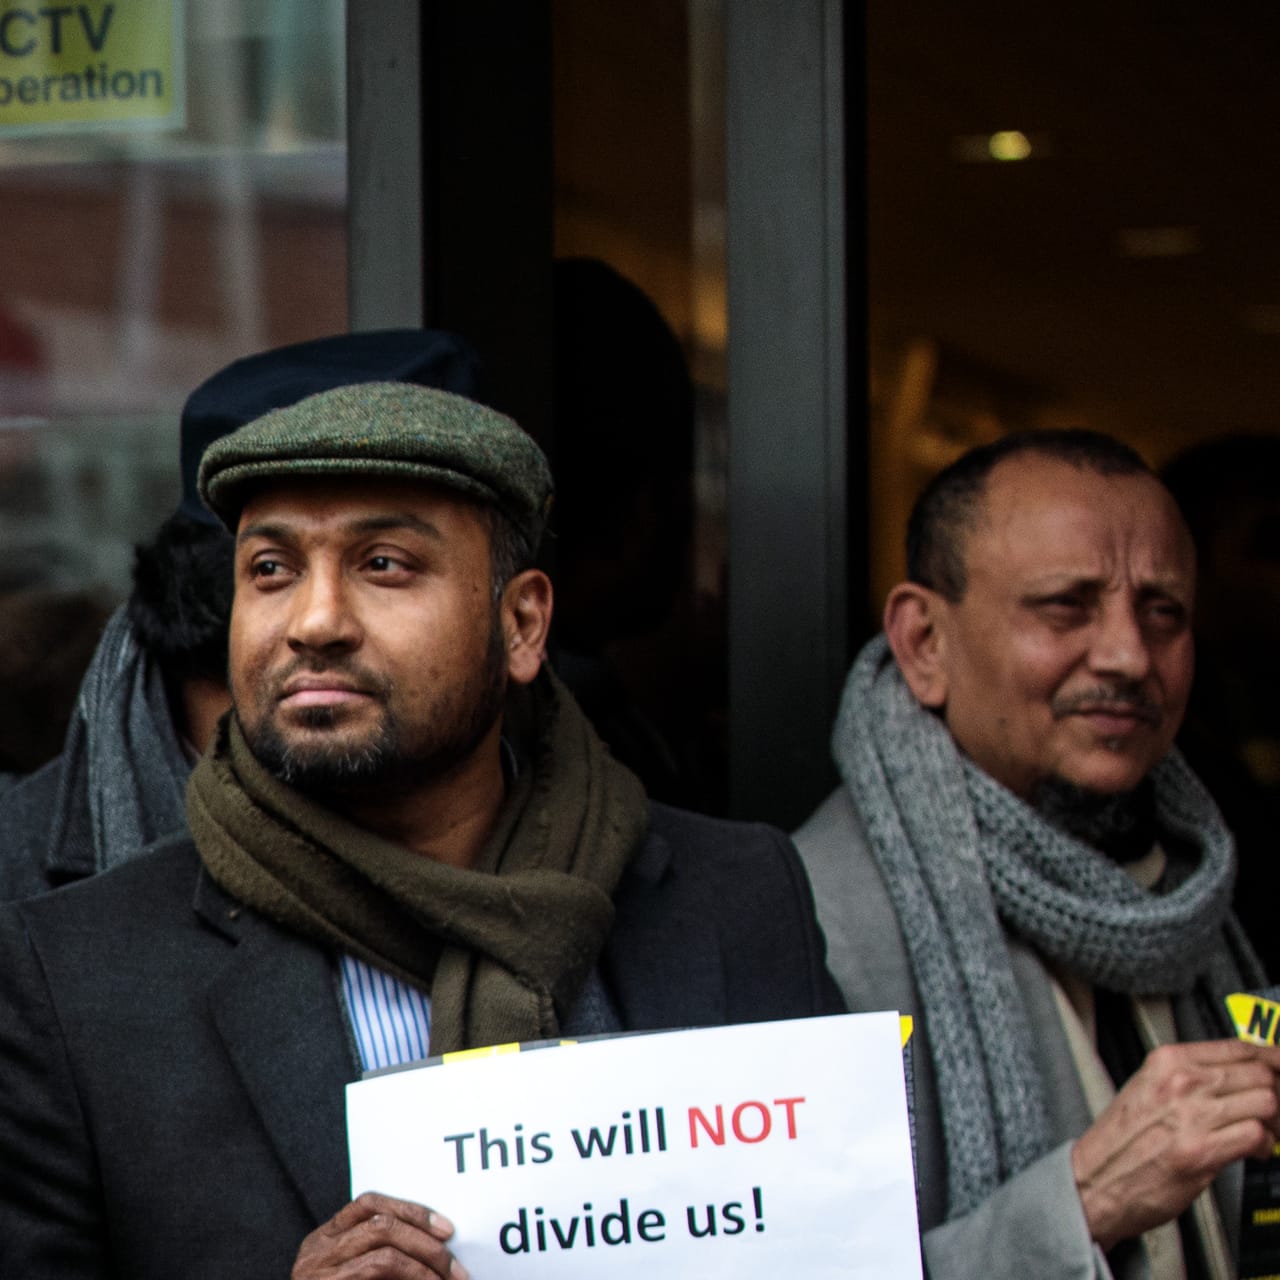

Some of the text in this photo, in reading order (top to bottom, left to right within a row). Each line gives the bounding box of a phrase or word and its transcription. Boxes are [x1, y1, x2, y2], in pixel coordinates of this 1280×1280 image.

[444, 1097, 806, 1174] This will NOT
[499, 1187, 766, 1254] divide us!
